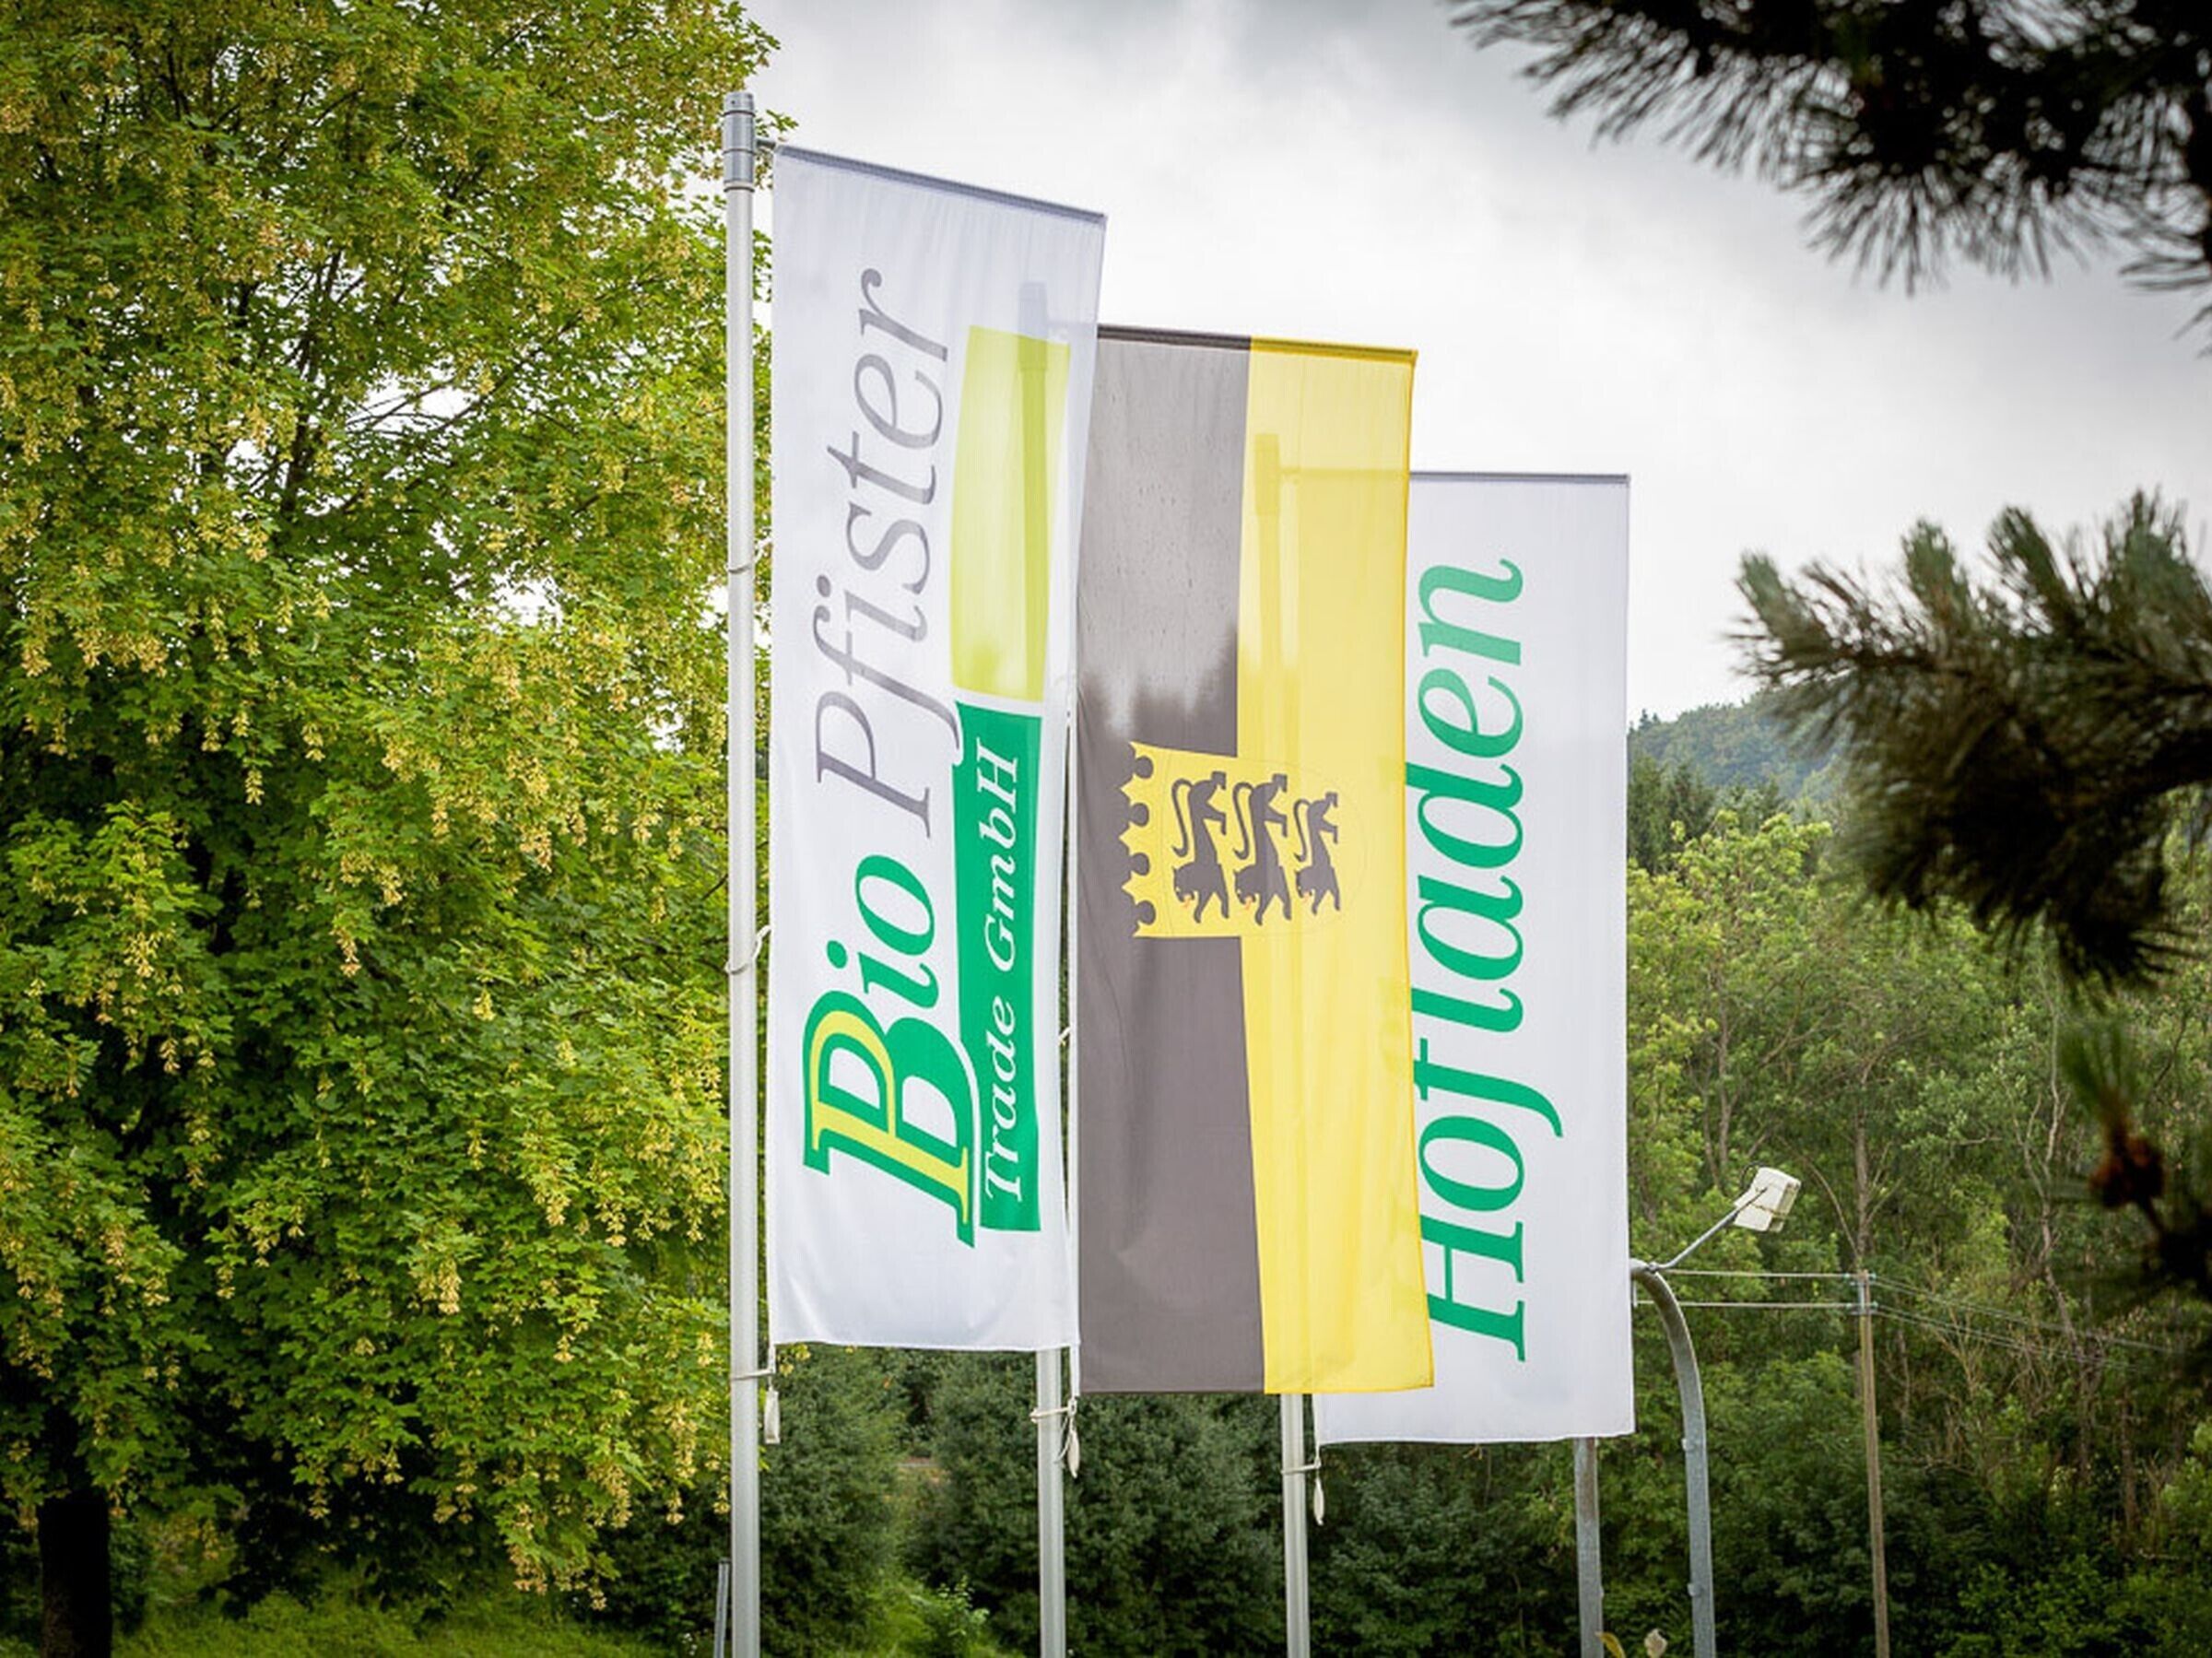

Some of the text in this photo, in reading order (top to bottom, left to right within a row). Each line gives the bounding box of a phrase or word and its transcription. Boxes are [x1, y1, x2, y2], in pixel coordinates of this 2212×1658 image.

[802, 266, 976, 1250] Bio Pfister
[976, 736, 1023, 1203] Trade GmbH
[1405, 556, 1564, 1363] Hofladen
